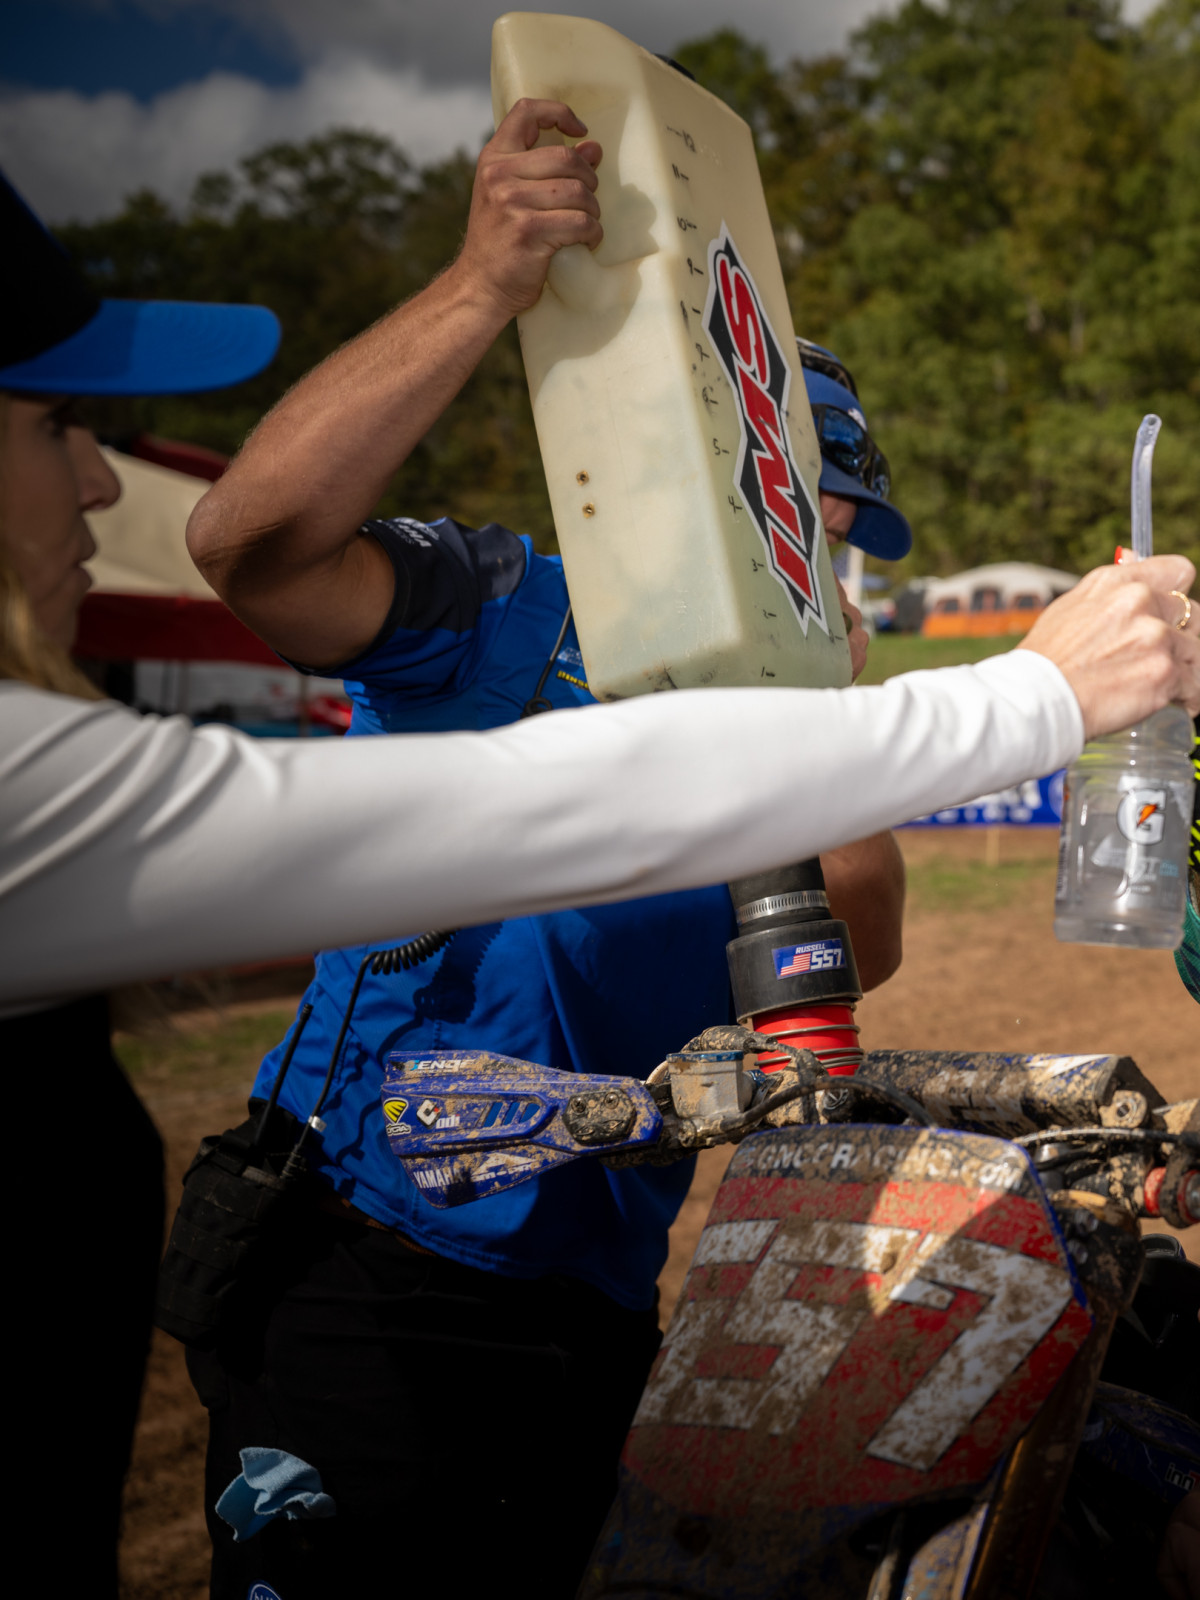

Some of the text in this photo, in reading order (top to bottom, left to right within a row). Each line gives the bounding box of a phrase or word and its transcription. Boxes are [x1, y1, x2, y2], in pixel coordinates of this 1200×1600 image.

[1117, 789, 1166, 845] G
[795, 943, 826, 955] RUSSELL
[413, 1167, 464, 1190] YAMAHA
